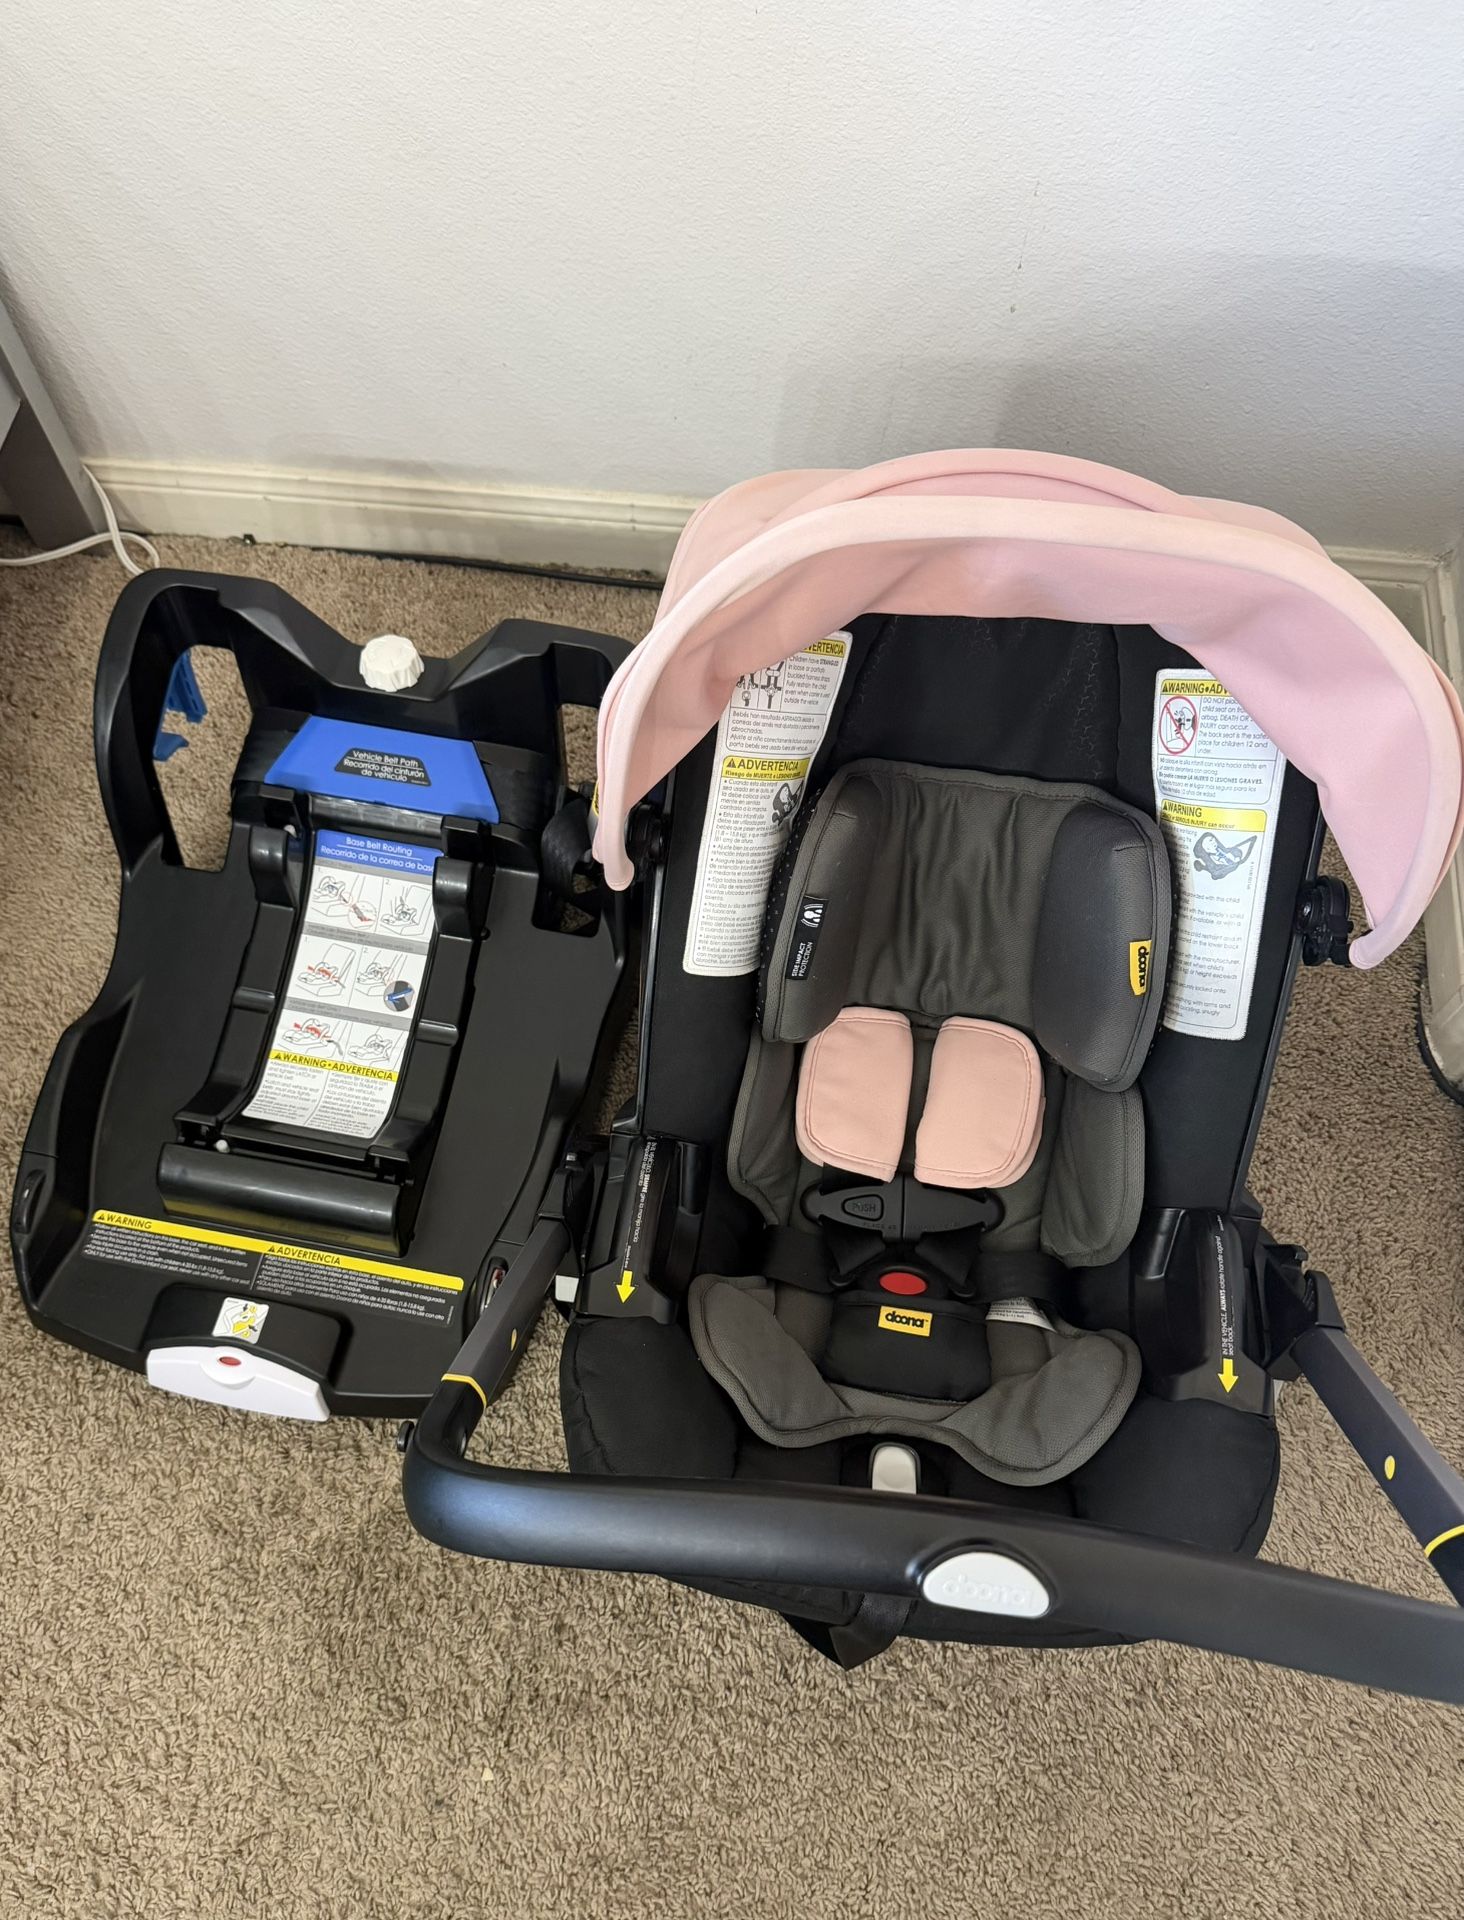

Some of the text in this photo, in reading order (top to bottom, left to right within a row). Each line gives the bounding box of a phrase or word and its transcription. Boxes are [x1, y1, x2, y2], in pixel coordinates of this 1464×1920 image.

[1168, 682, 1204, 694] WARNING
[1219, 714, 1238, 722] DEATH
[344, 759, 380, 770] Recorrido
[352, 750, 418, 767] Vehicle Belt Path
[738, 759, 798, 772] ADVERTENCIA
[1168, 801, 1202, 817] WARNING
[346, 837, 412, 856] Base Belt Routing
[321, 846, 357, 859] Recorrido
[358, 853, 369, 861] de
[370, 853, 377, 862] la
[379, 856, 404, 867] correa
[405, 860, 416, 869] de
[795, 942, 806, 964] IMPACT
[798, 942, 813, 976] PROTECTION
[1138, 946, 1149, 987] doona
[282, 1054, 393, 1080] WARNING ADVERTENCIA
[106, 1214, 152, 1230] WARNING
[276, 1247, 340, 1266] ADVERTENCIA
[885, 1311, 924, 1328] doona
